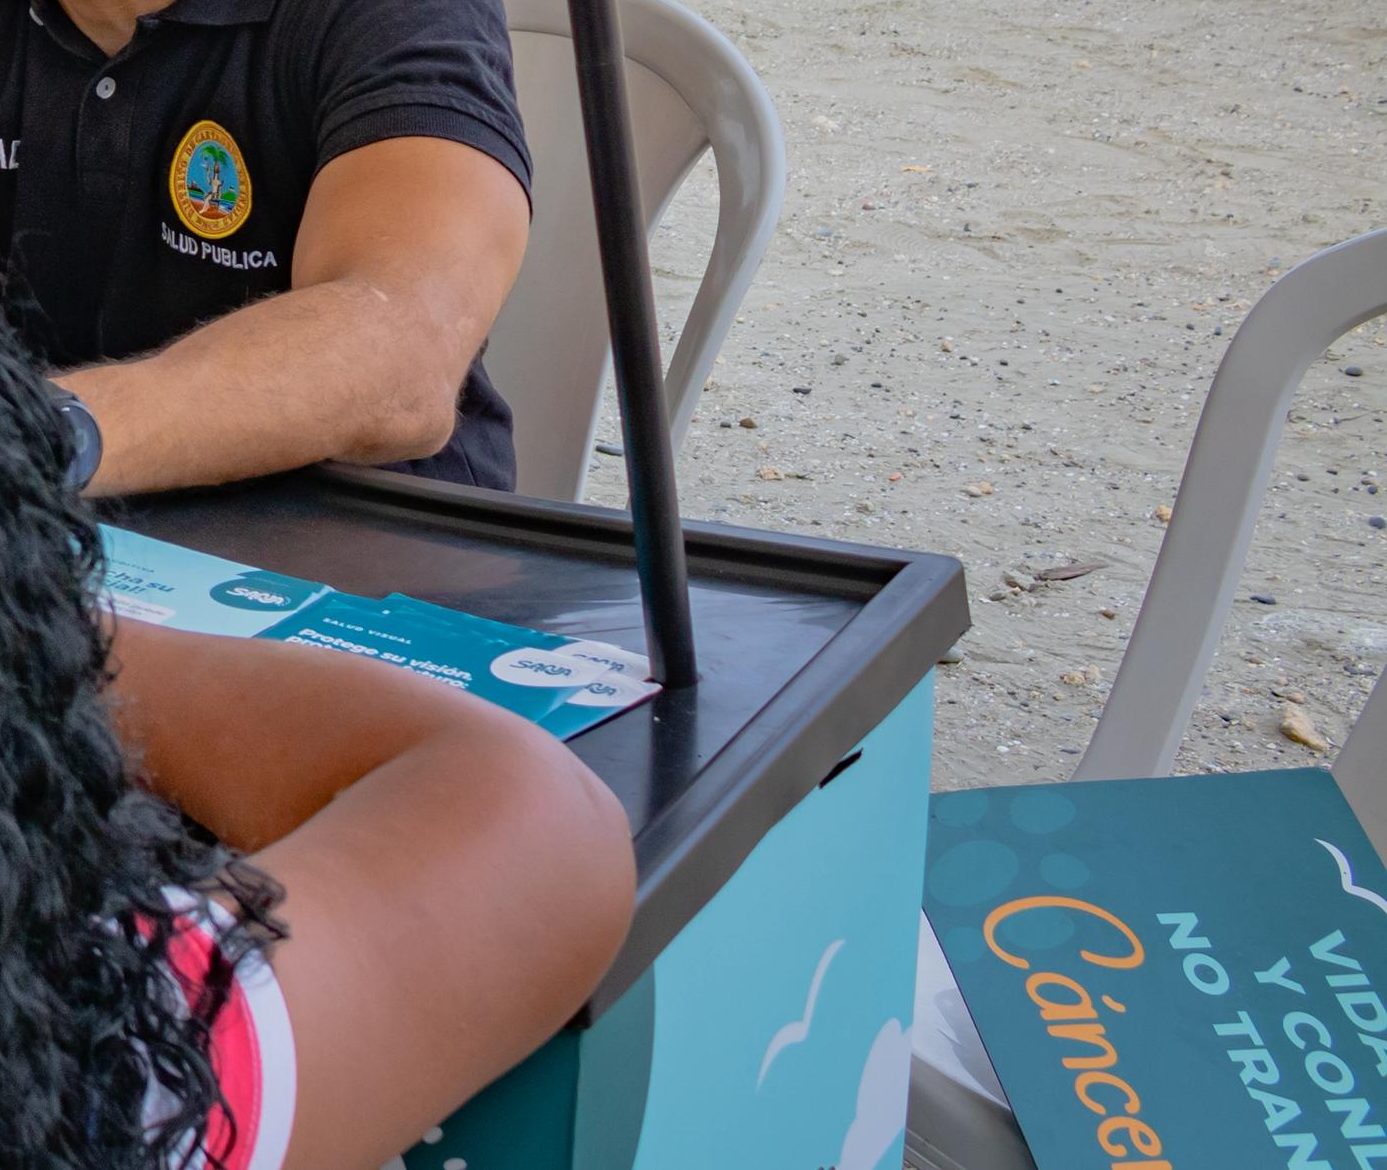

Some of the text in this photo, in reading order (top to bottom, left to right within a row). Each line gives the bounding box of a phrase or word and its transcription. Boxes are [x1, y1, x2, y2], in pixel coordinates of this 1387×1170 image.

[161, 221, 278, 270] SALUD PUBLICA
[323, 618, 411, 645] SALUD VISUAL
[380, 652, 407, 663] su
[1254, 956, 1306, 995] Y
[983, 896, 1173, 1170] Cánce
[1156, 912, 1333, 1170] NO TRAN
